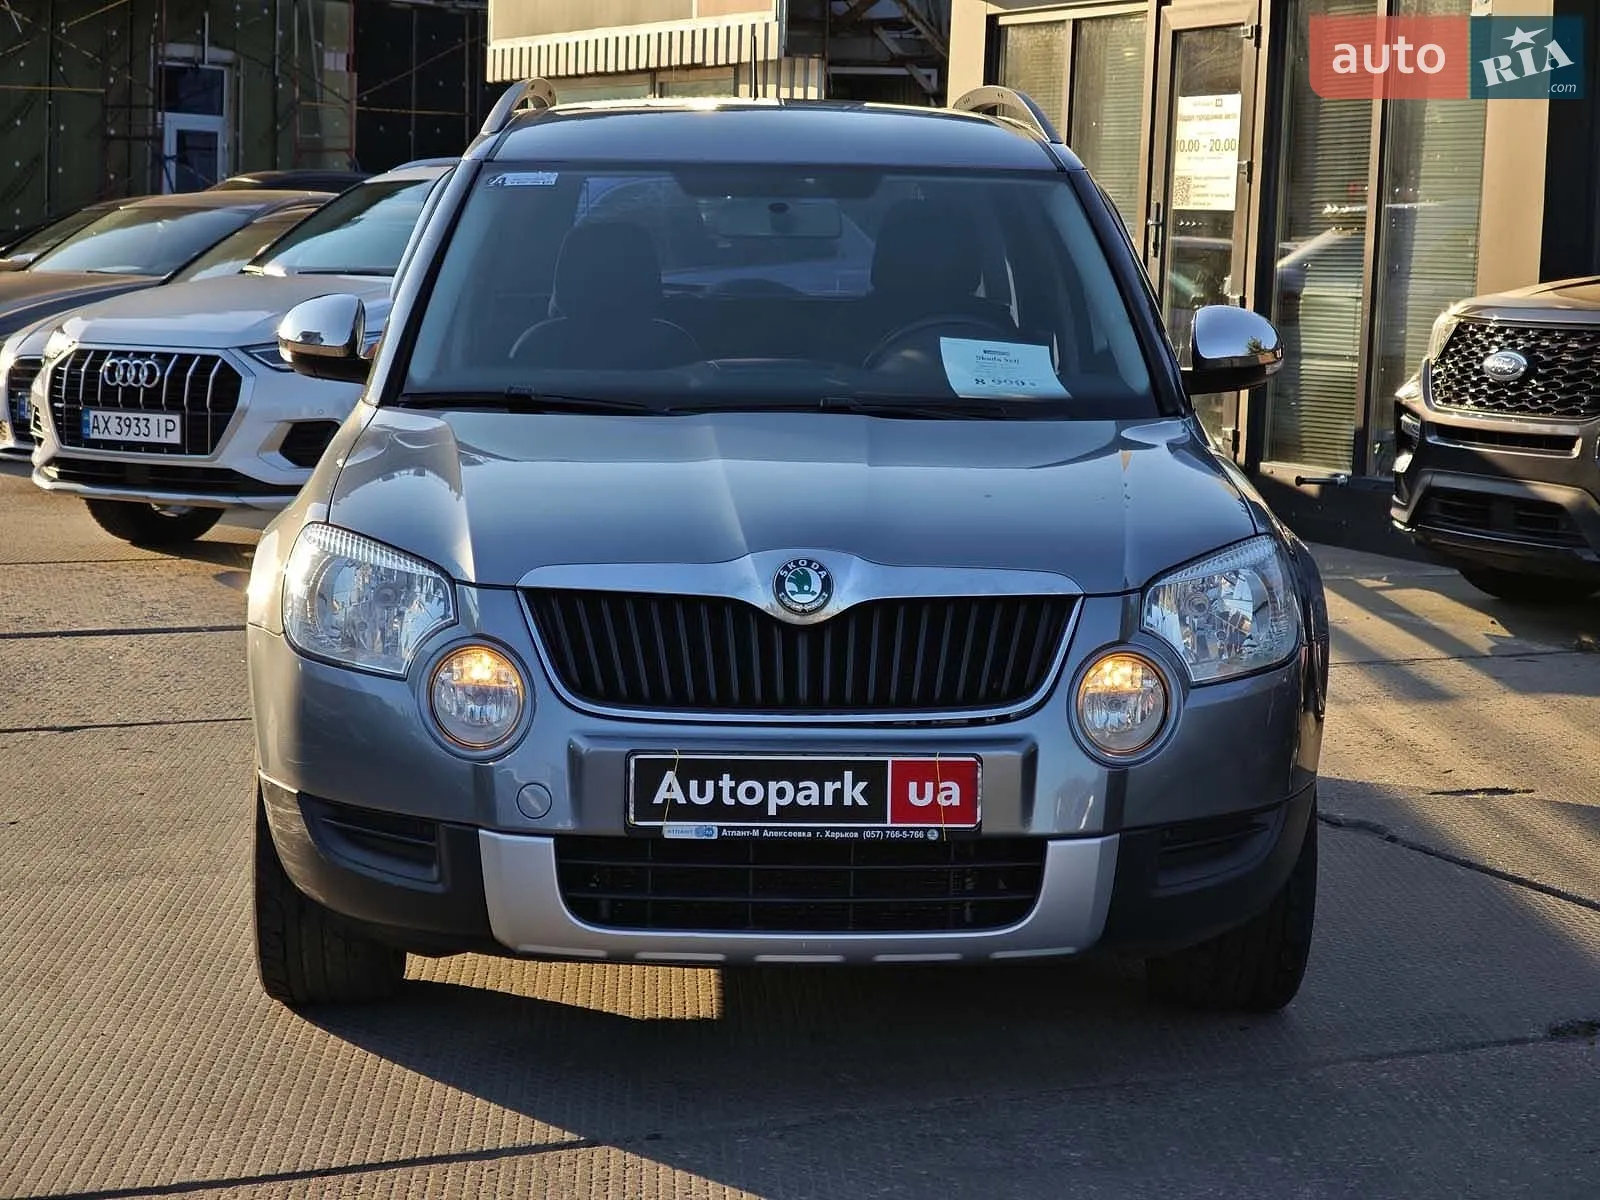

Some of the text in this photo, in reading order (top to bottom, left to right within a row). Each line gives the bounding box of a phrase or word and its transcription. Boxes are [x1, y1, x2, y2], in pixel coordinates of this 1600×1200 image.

[1176, 139, 1200, 153] 10.00
[1209, 139, 1237, 152] 20.00
[91, 413, 177, 440] AX 3933 IP
[652, 770, 961, 816] Autopark ua
[863, 830, 884, 840] (057)
